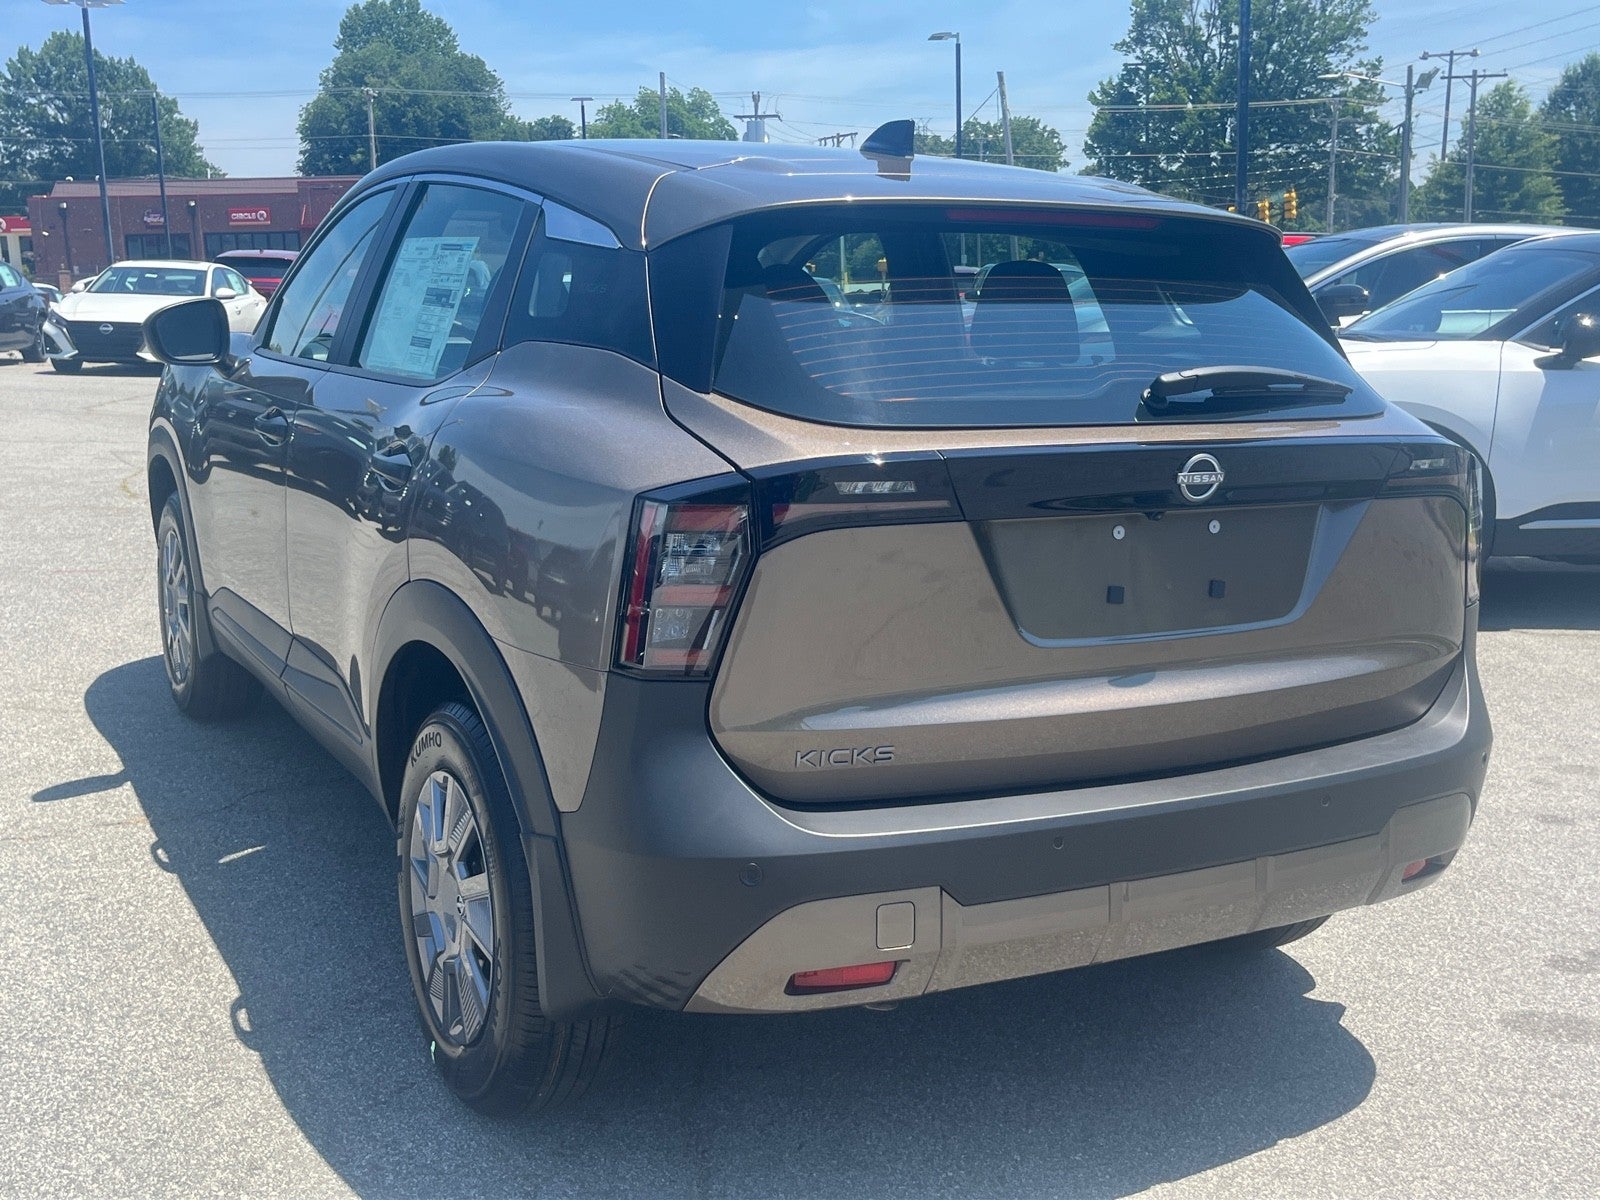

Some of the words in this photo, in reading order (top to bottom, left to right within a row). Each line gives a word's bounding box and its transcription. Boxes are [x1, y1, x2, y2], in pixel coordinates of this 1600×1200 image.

[231, 212, 256, 220] CIRCLE
[257, 210, 267, 221] K
[1178, 474, 1224, 483] NISSAN
[410, 732, 442, 767] KUMHO
[795, 745, 896, 768] KICKS
